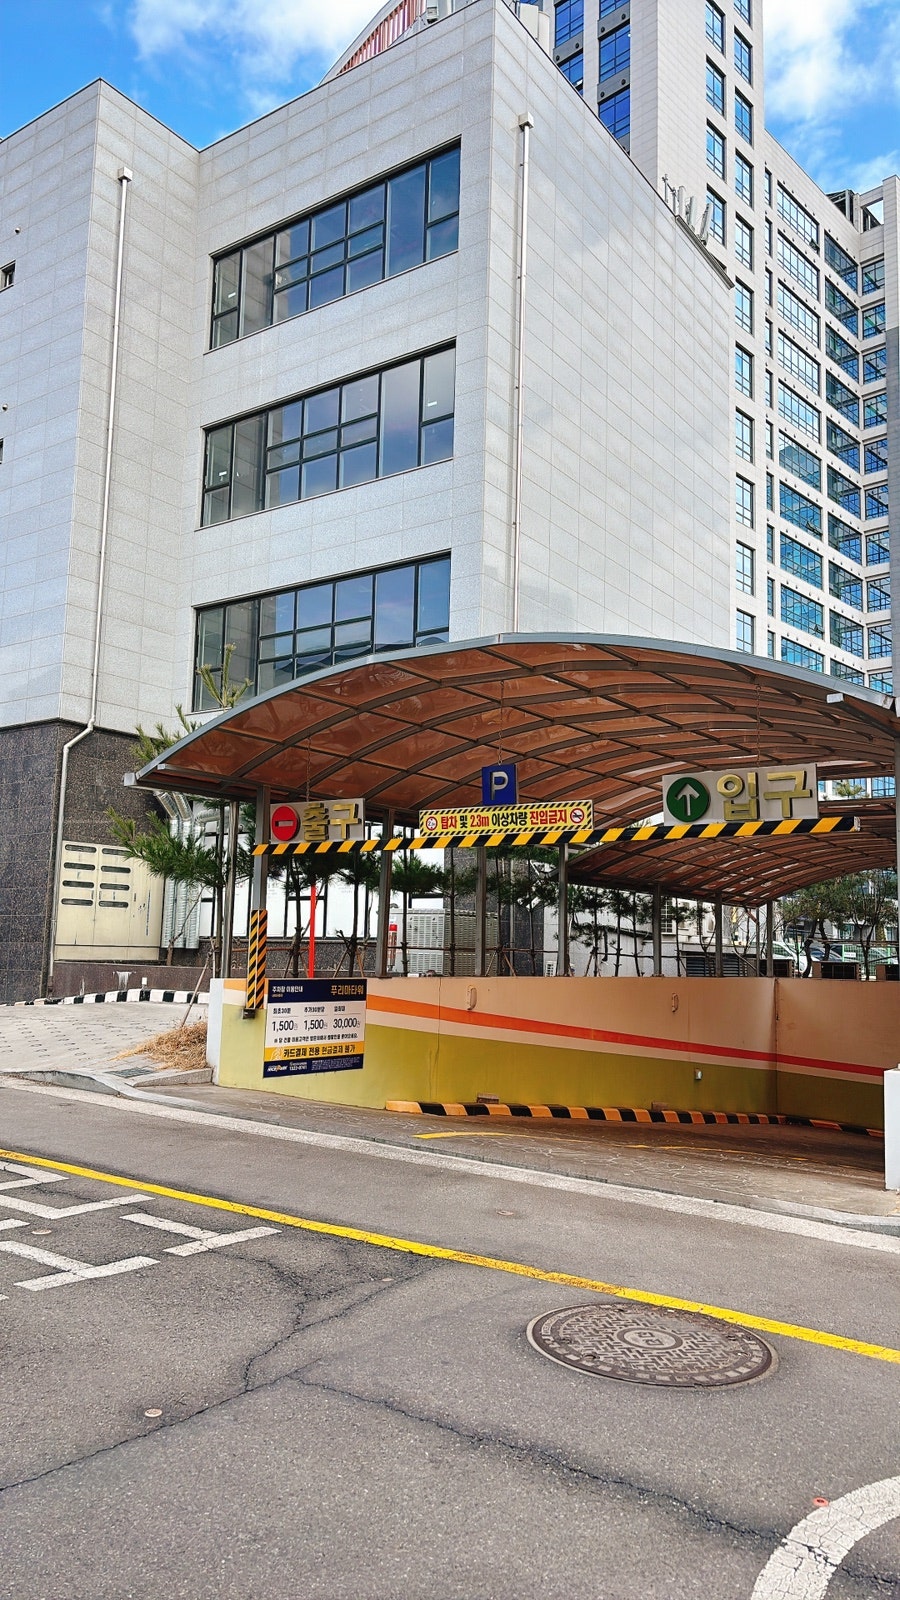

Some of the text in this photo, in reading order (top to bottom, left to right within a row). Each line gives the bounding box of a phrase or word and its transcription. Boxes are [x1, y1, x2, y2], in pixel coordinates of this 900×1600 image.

[490, 771, 509, 801] P
[716, 770, 812, 821] 입구
[302, 803, 361, 842] 출구
[441, 815, 457, 830] 탑차
[459, 814, 468, 829] 및
[470, 814, 490, 828] 2.3m
[491, 811, 527, 827] 이상차량
[529, 809, 567, 825] 진입금지
[330, 985, 364, 996] 푸리마타워
[283, 1047, 307, 1058] 카드결제
[309, 1047, 320, 1056] 전용
[321, 1045, 343, 1055] 현금결제
